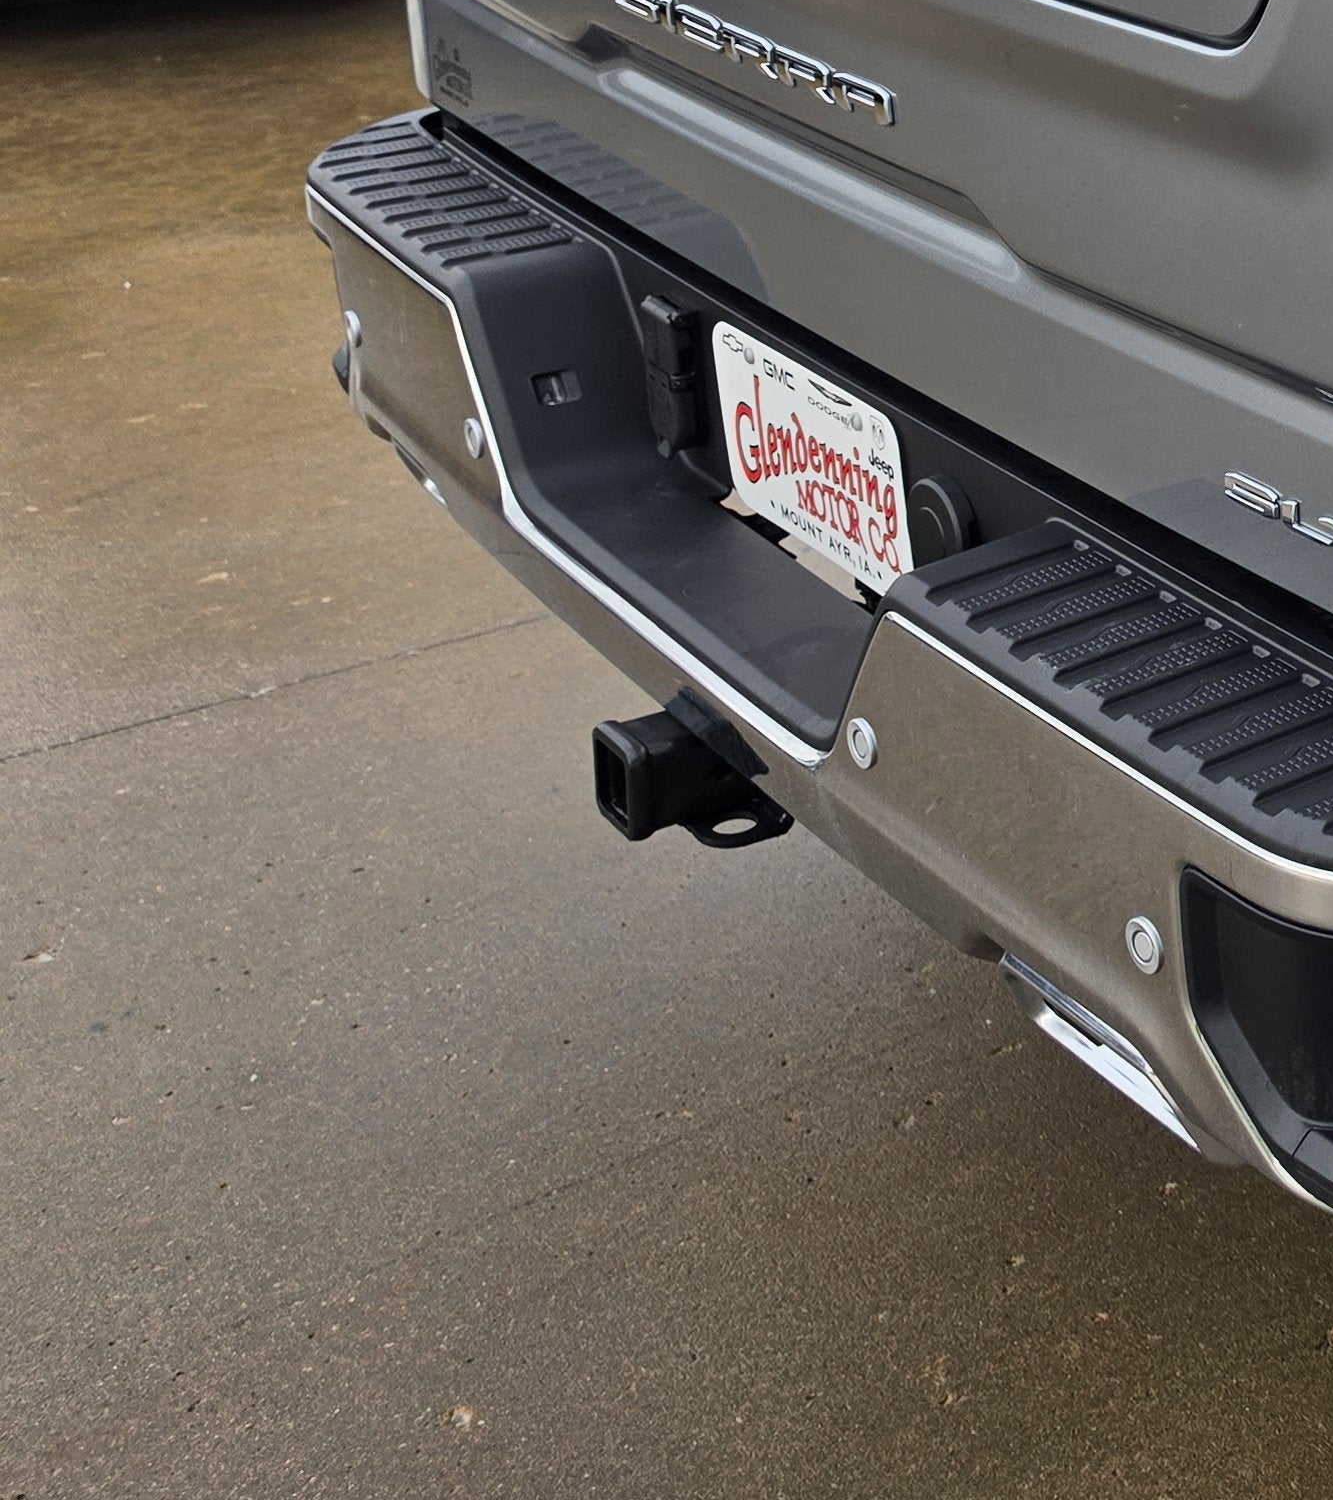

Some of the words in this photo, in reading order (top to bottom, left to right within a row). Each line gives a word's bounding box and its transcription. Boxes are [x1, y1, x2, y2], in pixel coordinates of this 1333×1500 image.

[762, 358, 796, 391] GMC
[807, 396, 849, 425] DODGE
[735, 374, 898, 539] Glendenning
[868, 449, 895, 481] Jeep
[780, 503, 823, 542] MOUNT
[795, 480, 868, 555] MOTOR
